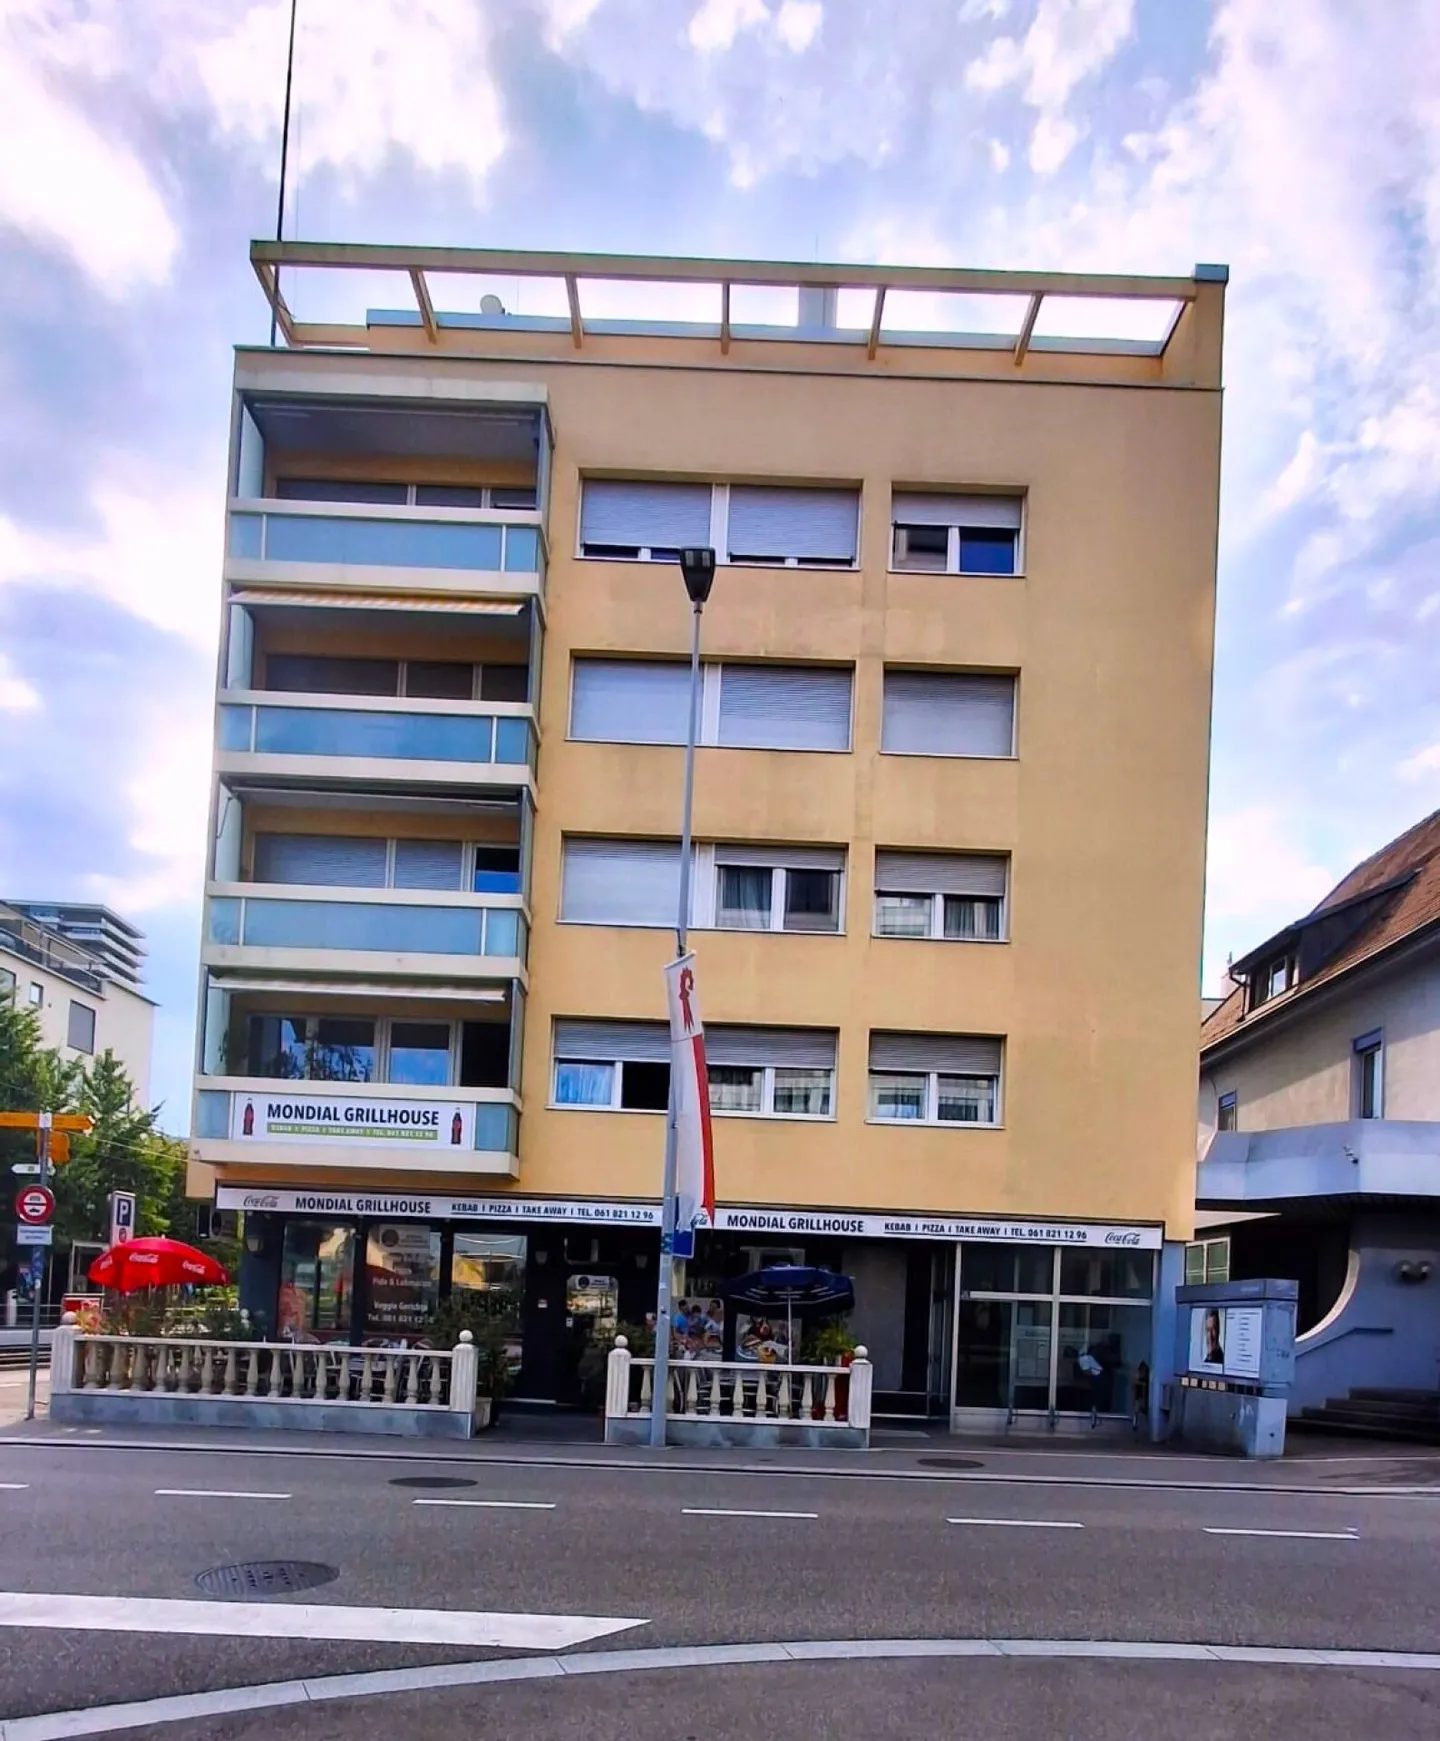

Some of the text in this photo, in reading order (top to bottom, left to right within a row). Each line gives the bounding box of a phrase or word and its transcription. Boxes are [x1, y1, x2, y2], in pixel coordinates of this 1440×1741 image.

[267, 1103, 439, 1126] MONDIAL GRILLHOUSE
[119, 1201, 129, 1223] P
[295, 1196, 431, 1214] MONDIAL GRILLHOUSE
[452, 1203, 478, 1212] KEBAB
[489, 1204, 512, 1213] PIZZA
[522, 1205, 541, 1214] TAKE
[543, 1206, 567, 1215] AWAY
[594, 1208, 610, 1217] 061
[612, 1209, 628, 1218] 821
[631, 1210, 641, 1219] 12
[643, 1211, 654, 1220] 96
[727, 1214, 864, 1233] MONDIAL GRILLHOUSE
[884, 1222, 911, 1232] KEBAB
[922, 1224, 945, 1233] PIZZA
[955, 1225, 975, 1234] TAKE
[977, 1226, 1000, 1235] AWAY
[1028, 1228, 1043, 1237] 061
[1046, 1229, 1061, 1238] 821
[1065, 1230, 1075, 1239] 12
[1077, 1231, 1087, 1240] 96
